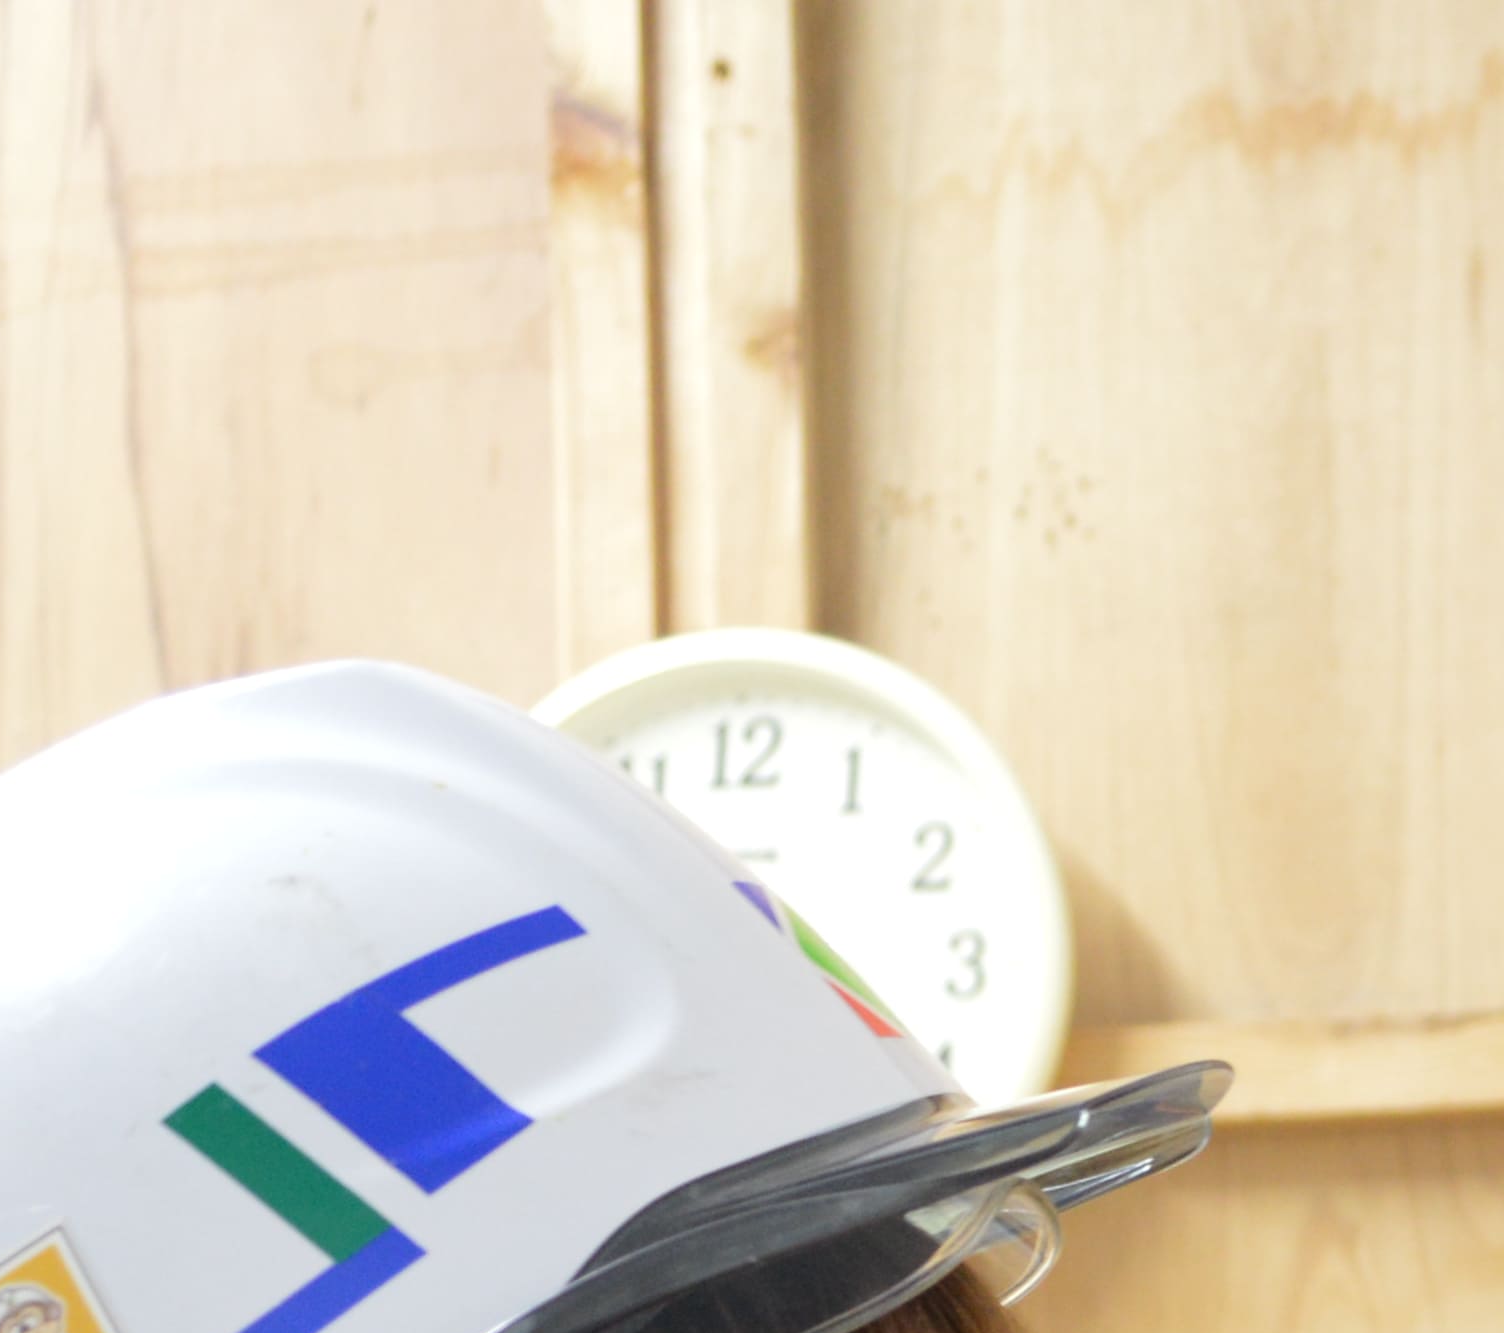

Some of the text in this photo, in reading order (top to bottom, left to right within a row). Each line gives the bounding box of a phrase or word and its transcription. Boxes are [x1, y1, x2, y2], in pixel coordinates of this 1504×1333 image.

[620, 752, 668, 796] 1
[709, 714, 785, 790] 12
[841, 745, 862, 816] 1
[909, 820, 956, 894] 2
[944, 928, 988, 1001] 3
